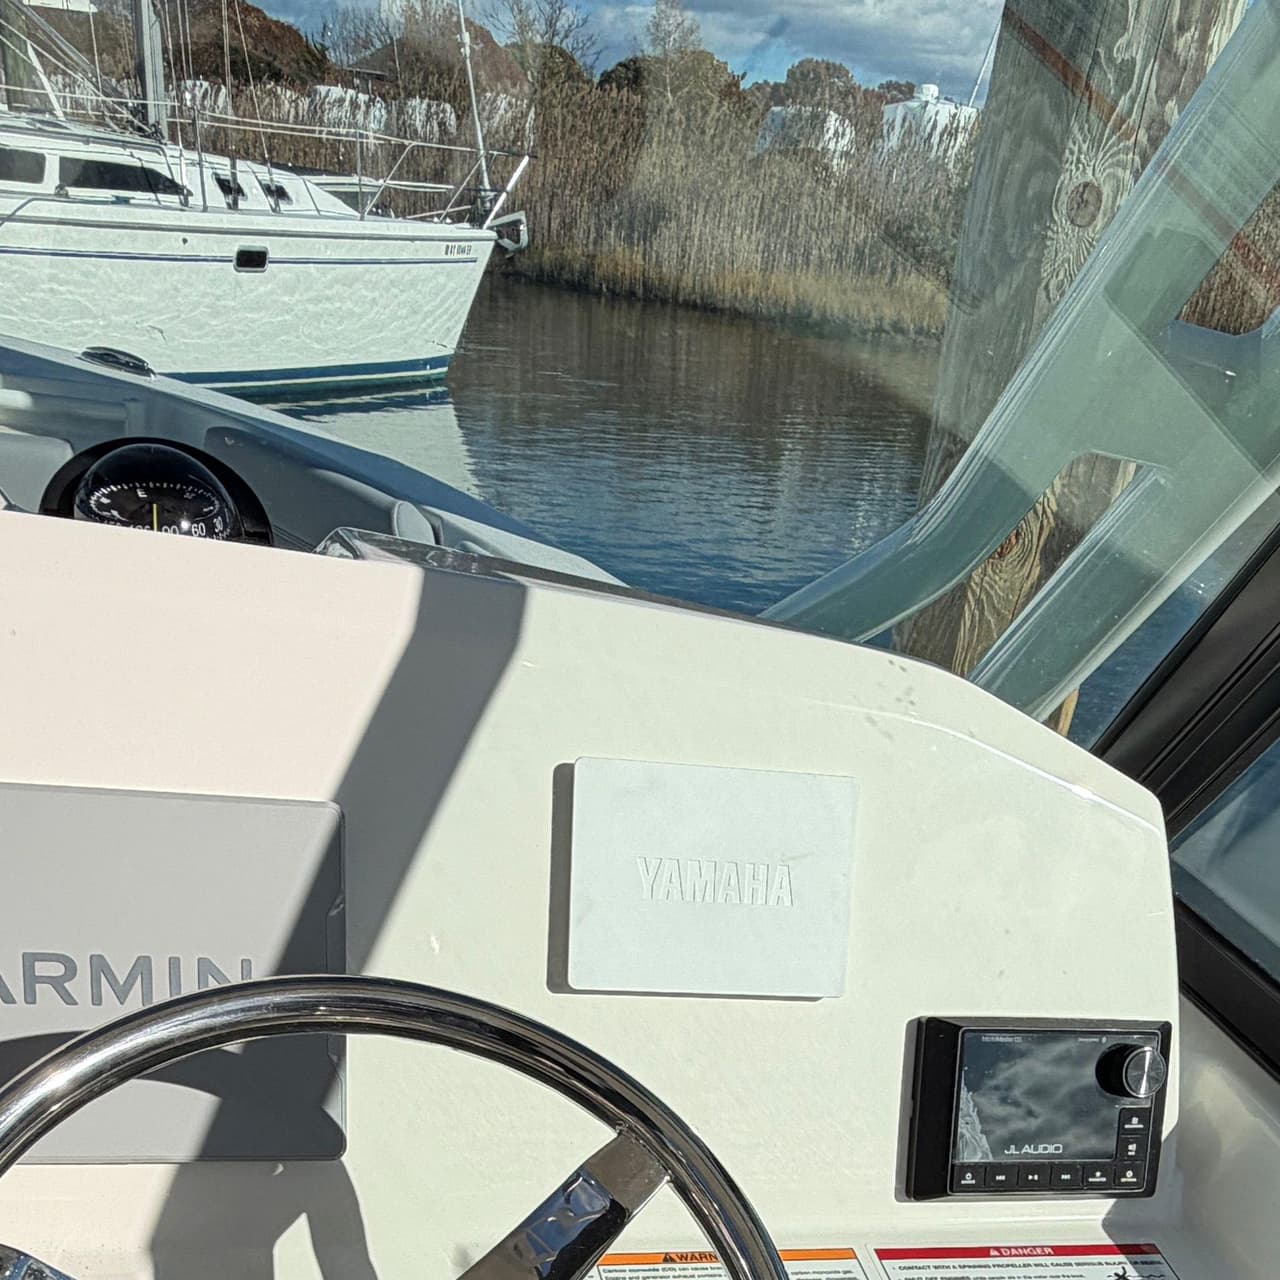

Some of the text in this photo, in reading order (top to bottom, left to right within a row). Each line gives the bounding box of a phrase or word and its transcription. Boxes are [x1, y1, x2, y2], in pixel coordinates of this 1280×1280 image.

[191, 522, 206, 537] 60
[635, 856, 794, 906] YAMAHA
[1004, 1143, 1064, 1155] JL AUDIO
[676, 1253, 719, 1262] WARN
[1001, 1247, 1055, 1256] DANGER
